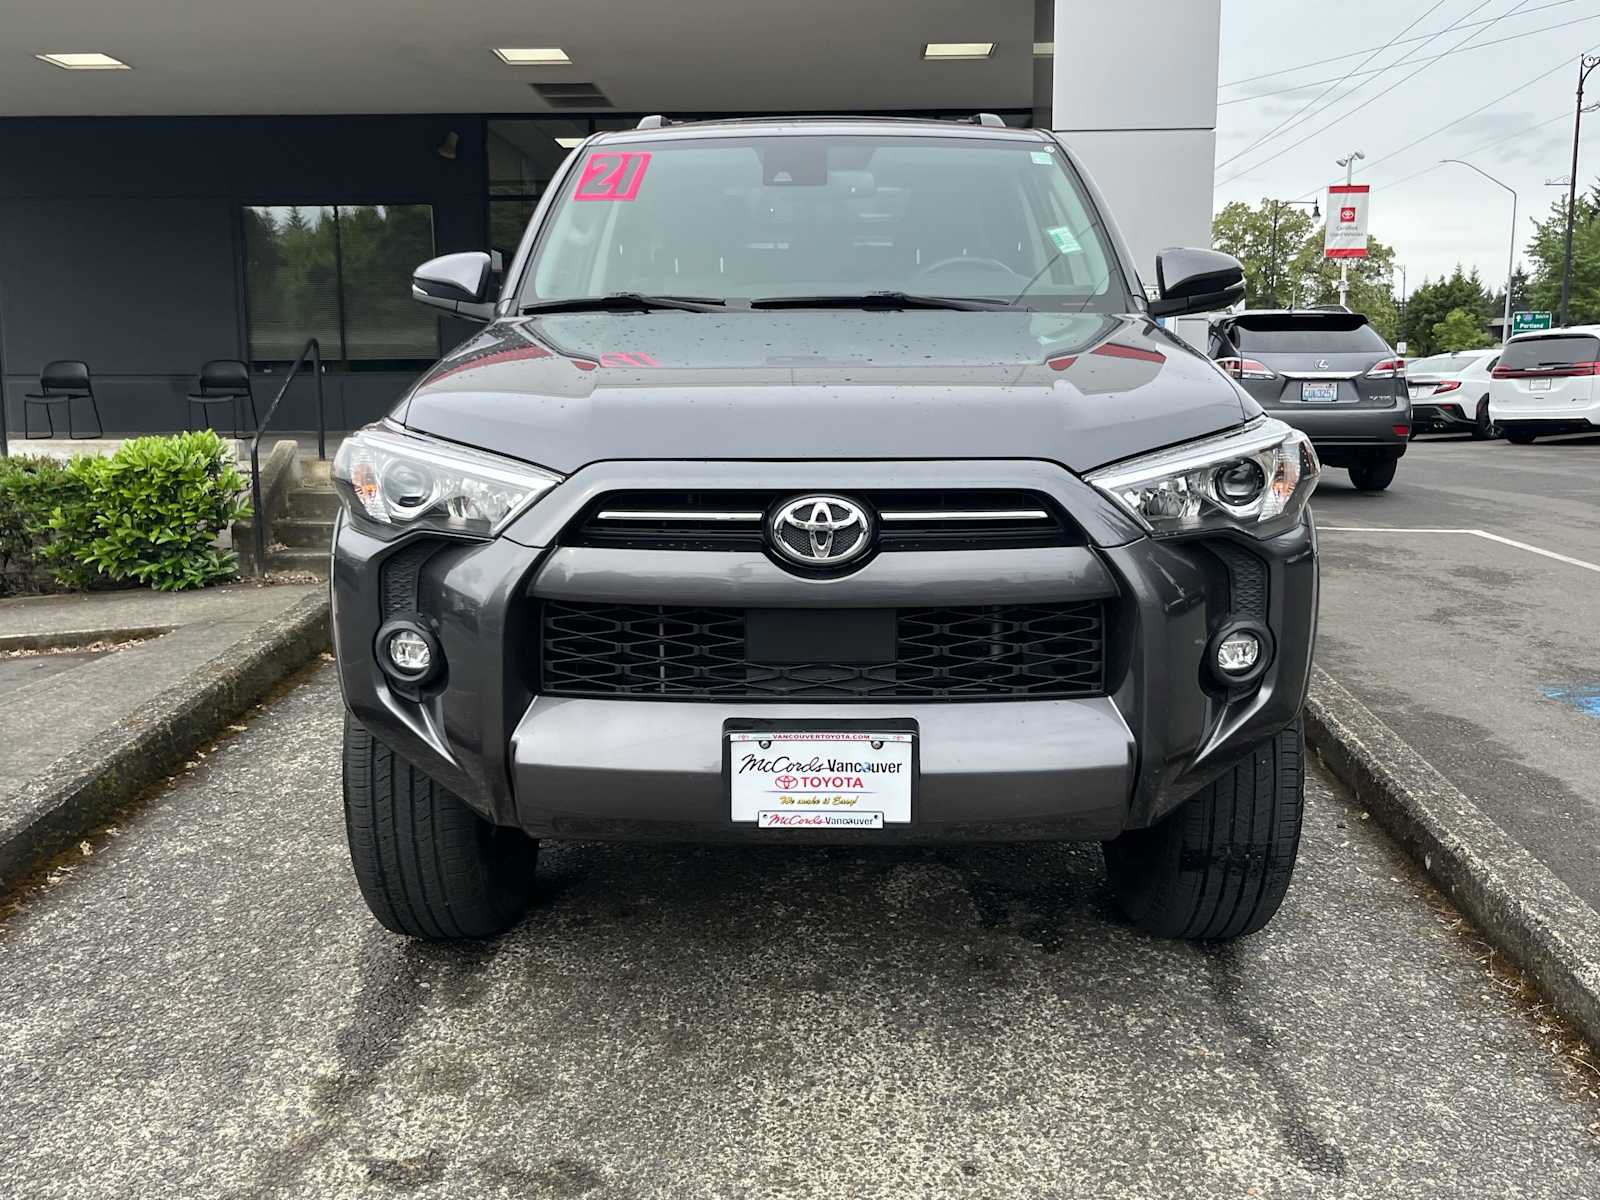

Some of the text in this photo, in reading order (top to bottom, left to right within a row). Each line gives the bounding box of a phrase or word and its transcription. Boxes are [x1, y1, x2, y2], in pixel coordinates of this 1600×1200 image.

[580, 156, 641, 195] 21
[739, 753, 902, 774] McCords Vancouver
[801, 777, 864, 788] TOYOTA
[767, 813, 873, 826] McCords Vancouver
